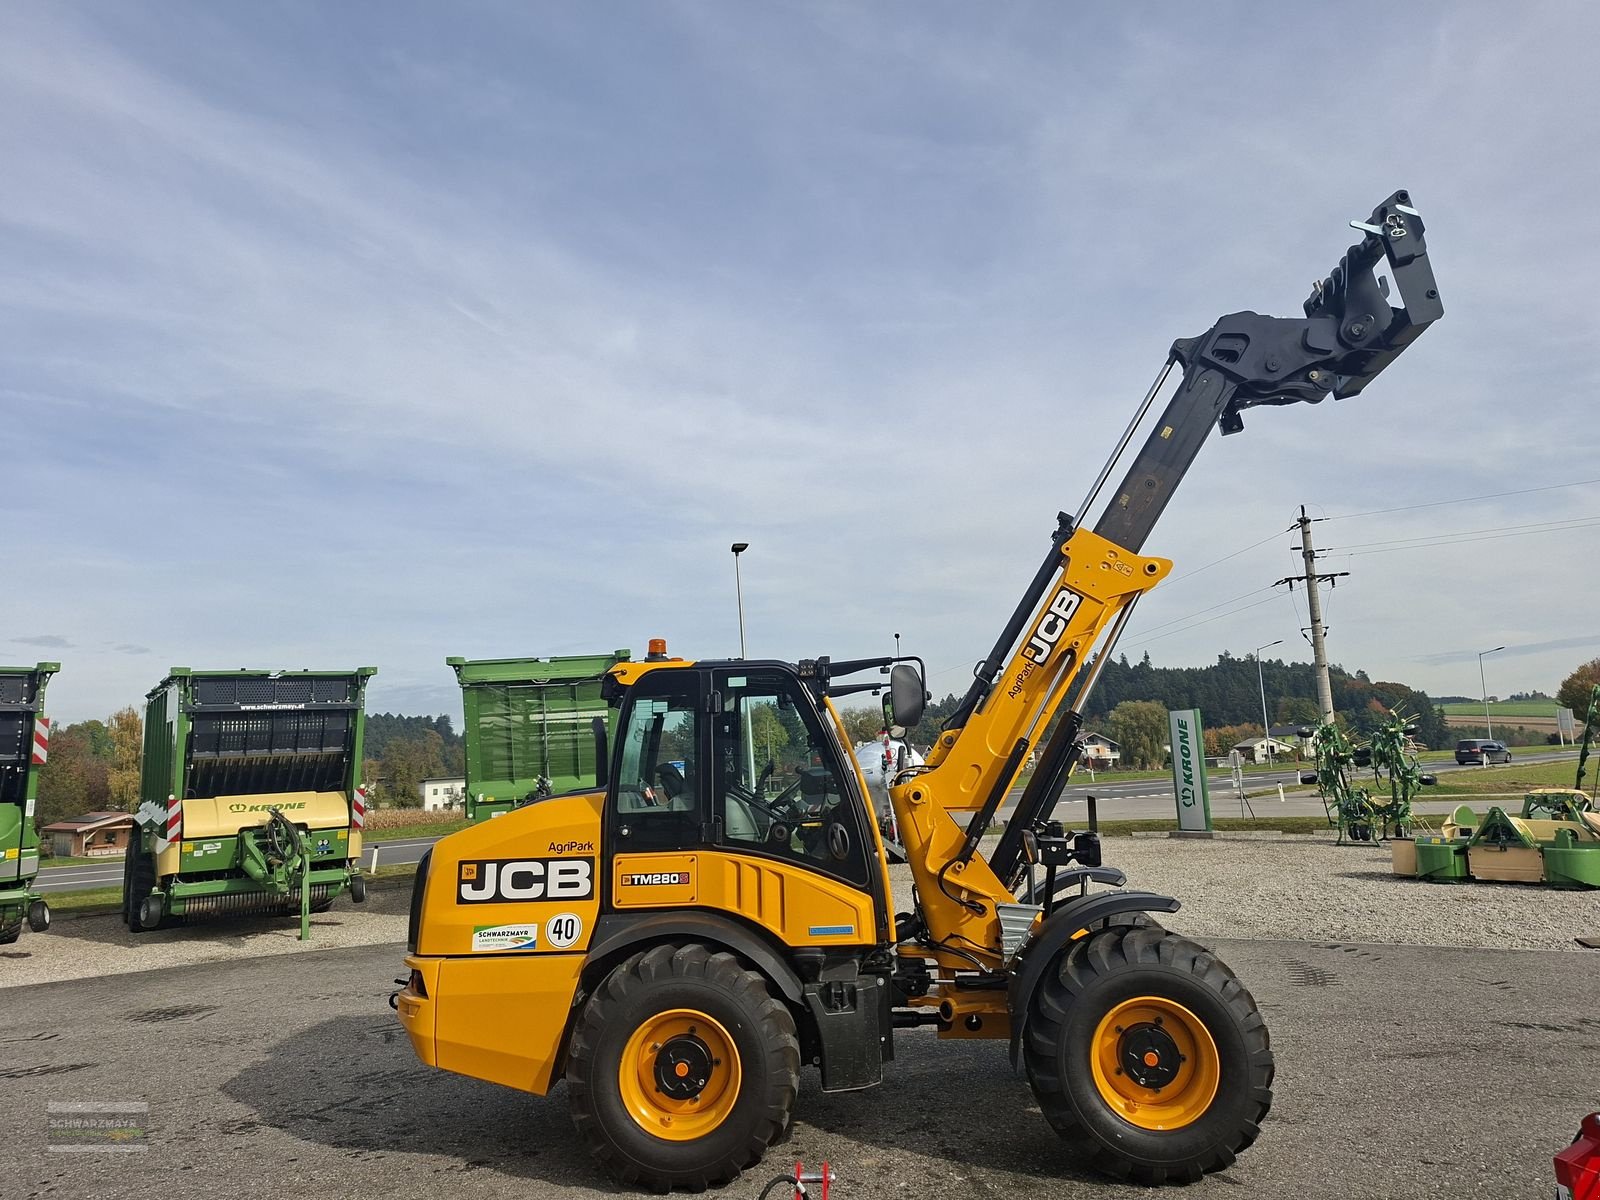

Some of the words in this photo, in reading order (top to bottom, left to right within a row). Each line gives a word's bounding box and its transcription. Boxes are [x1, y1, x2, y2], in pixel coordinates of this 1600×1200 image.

[1030, 590, 1080, 663] JCB
[1008, 661, 1034, 699] AgriPark
[1177, 718, 1194, 787] KRONE
[548, 841, 594, 854] AgriPark
[461, 860, 591, 900] JCB
[478, 930, 529, 938] SCHWARZMAYR
[552, 918, 575, 940] 40
